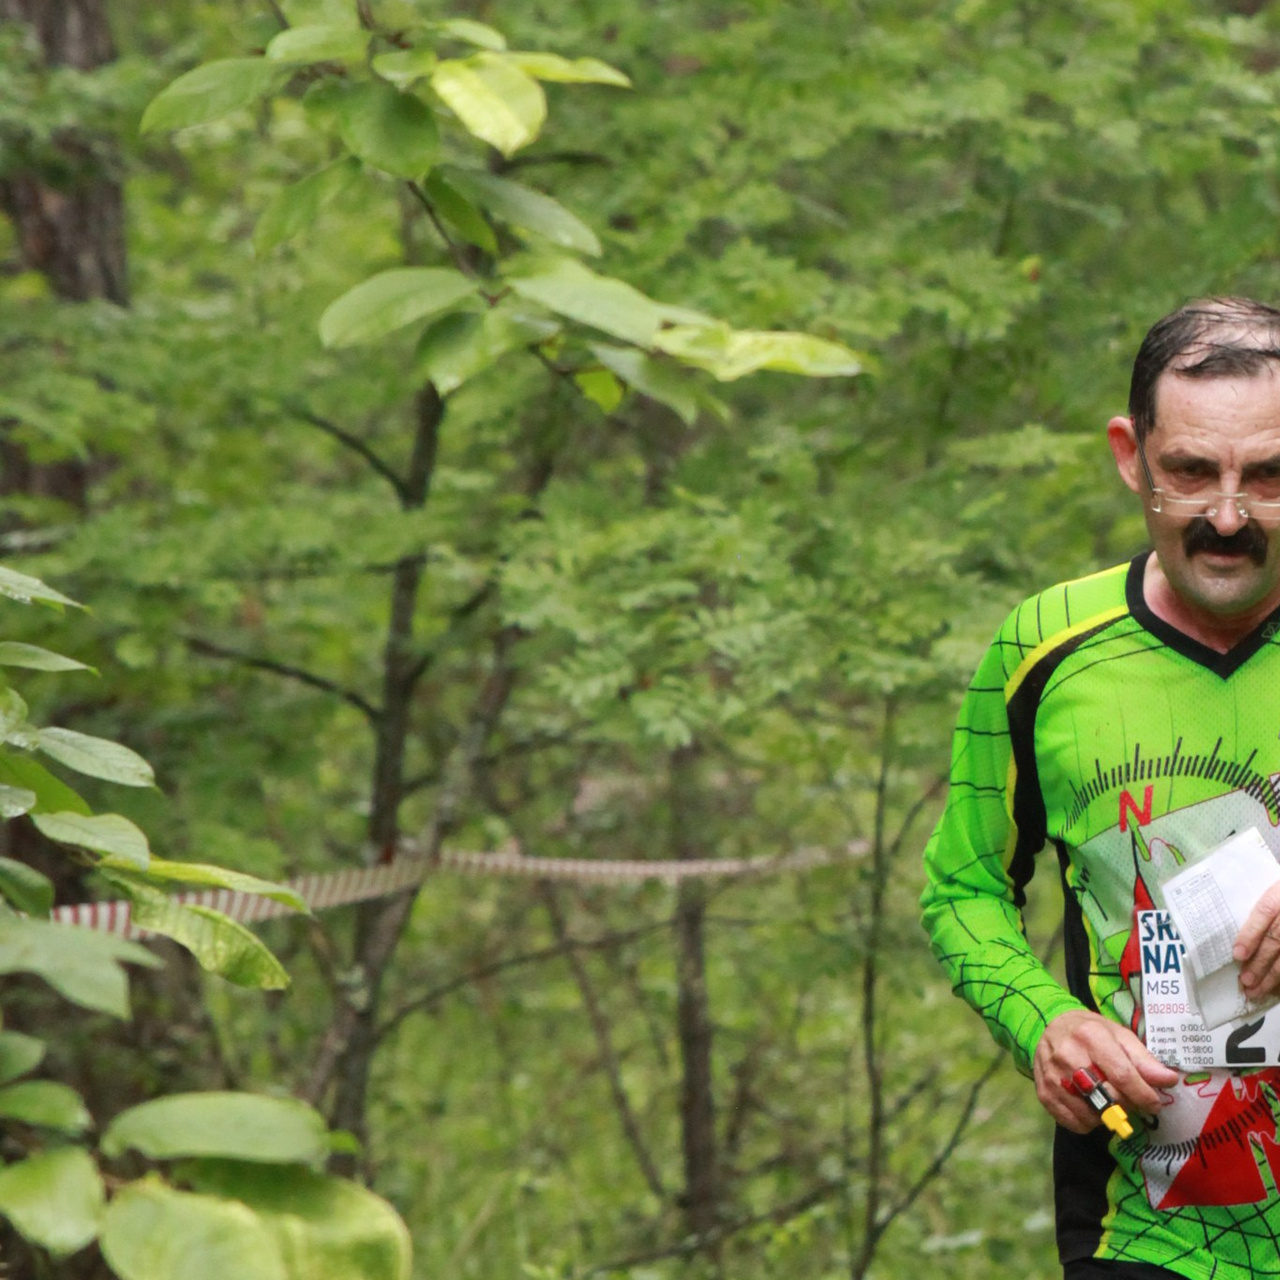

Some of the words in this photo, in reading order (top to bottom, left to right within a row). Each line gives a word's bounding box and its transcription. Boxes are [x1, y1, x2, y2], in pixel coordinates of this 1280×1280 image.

[1119, 784, 1154, 833] N
[1141, 912, 1181, 941] SK
[1180, 1024, 1206, 1032] 0:00:0
